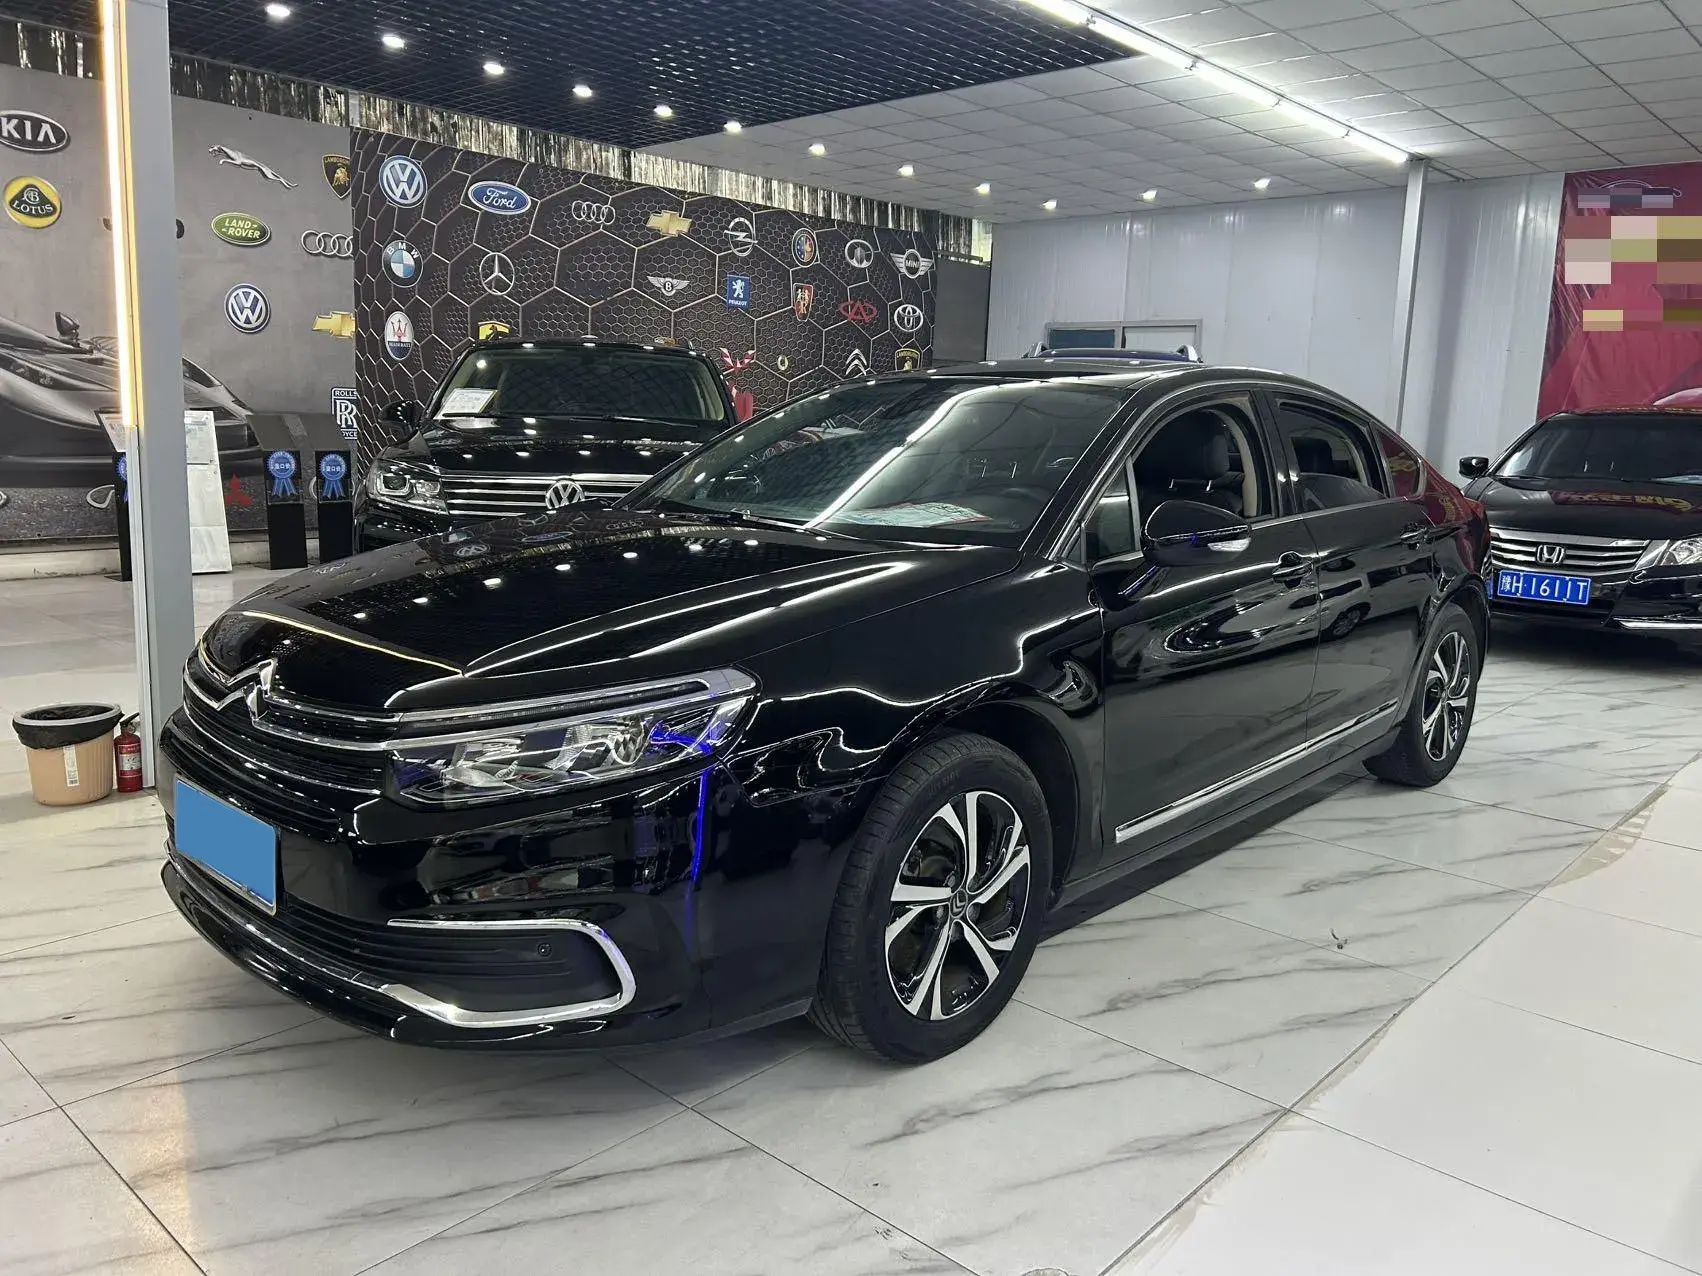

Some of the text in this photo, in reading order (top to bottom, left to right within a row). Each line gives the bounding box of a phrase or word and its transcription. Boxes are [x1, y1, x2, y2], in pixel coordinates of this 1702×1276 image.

[0, 117, 57, 144] KIA
[482, 187, 518, 208] Ford
[12, 200, 54, 215] LOTUS
[386, 241, 420, 259] BMW
